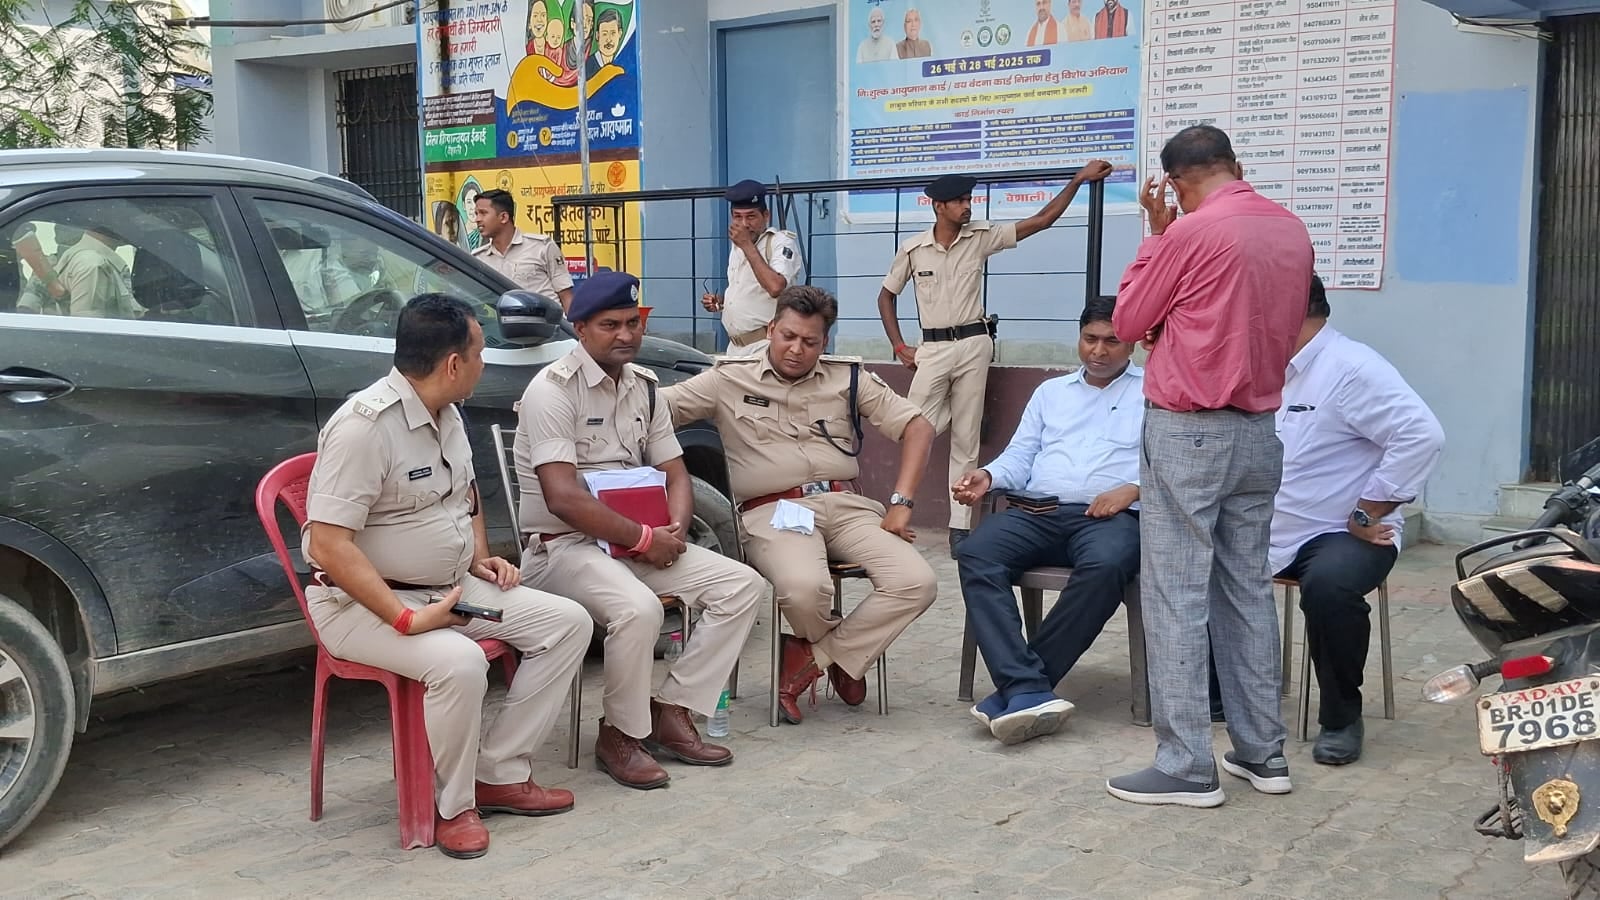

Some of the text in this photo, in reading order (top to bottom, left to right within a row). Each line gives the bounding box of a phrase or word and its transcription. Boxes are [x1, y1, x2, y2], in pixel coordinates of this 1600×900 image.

[468, 16, 501, 36] जिम्मेदारी
[460, 37, 477, 55] हमारी
[485, 52, 502, 71] इलाज
[930, 64, 942, 74] 26
[944, 60, 956, 74] मई
[969, 60, 981, 70] 28
[984, 56, 996, 69] मई
[1000, 56, 1023, 67] 2025
[1026, 54, 1042, 65] तक
[890, 85, 927, 97] आयुष्मान
[928, 81, 946, 91] कार्ड
[954, 81, 967, 89] वय
[969, 79, 992, 89] वंदना
[993, 75, 1012, 86] कार्ड
[1014, 74, 1043, 85] निर्माण
[1045, 73, 1060, 84] हेतु
[1062, 69, 1087, 80] विशेष
[1088, 66, 1129, 78] अभियान
[955, 109, 969, 118] कार्ड
[971, 107, 996, 117] निर्माण
[601, 119, 632, 140] आयुष्मान
[1500, 681, 1583, 706] YADAV
[1489, 691, 1594, 725] BR-01DE
[1491, 710, 1598, 749] 7968
